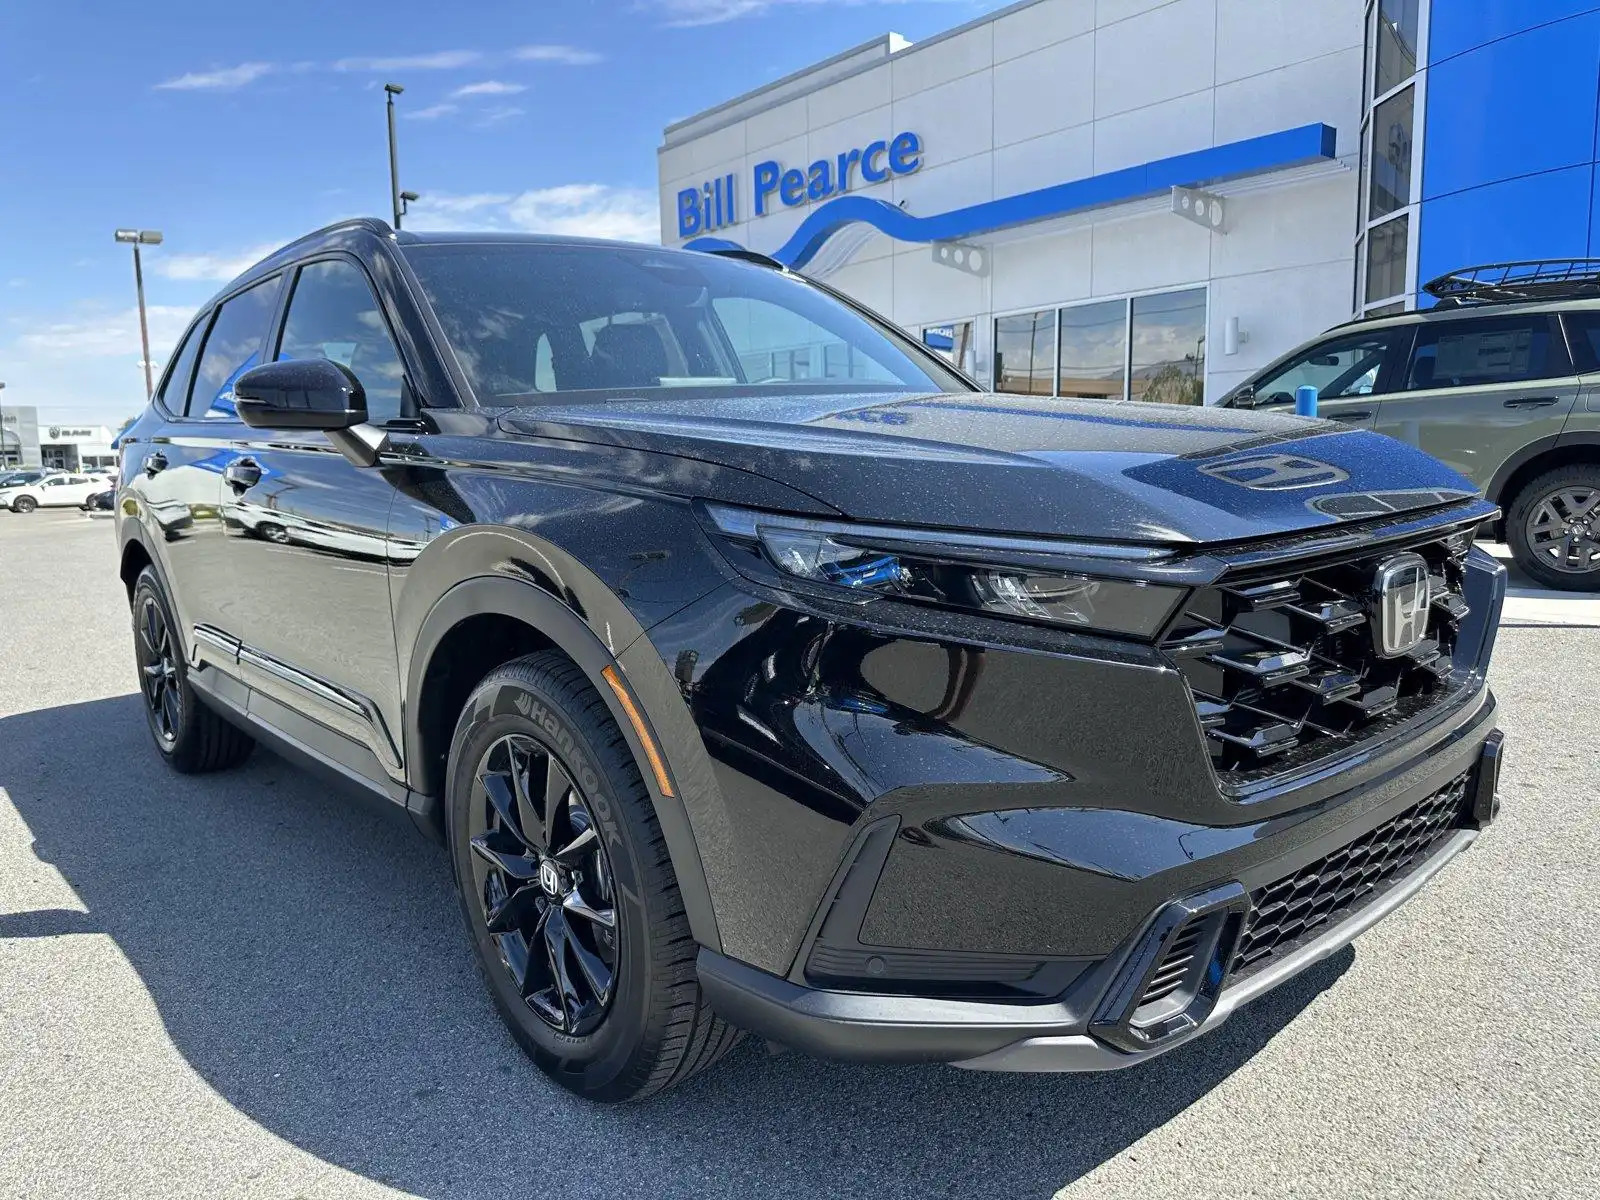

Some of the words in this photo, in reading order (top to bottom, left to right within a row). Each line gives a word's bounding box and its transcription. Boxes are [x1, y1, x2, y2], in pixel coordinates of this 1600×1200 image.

[677, 173, 737, 238] Bill
[754, 131, 922, 217] Pearce
[531, 699, 623, 848] Hankook
